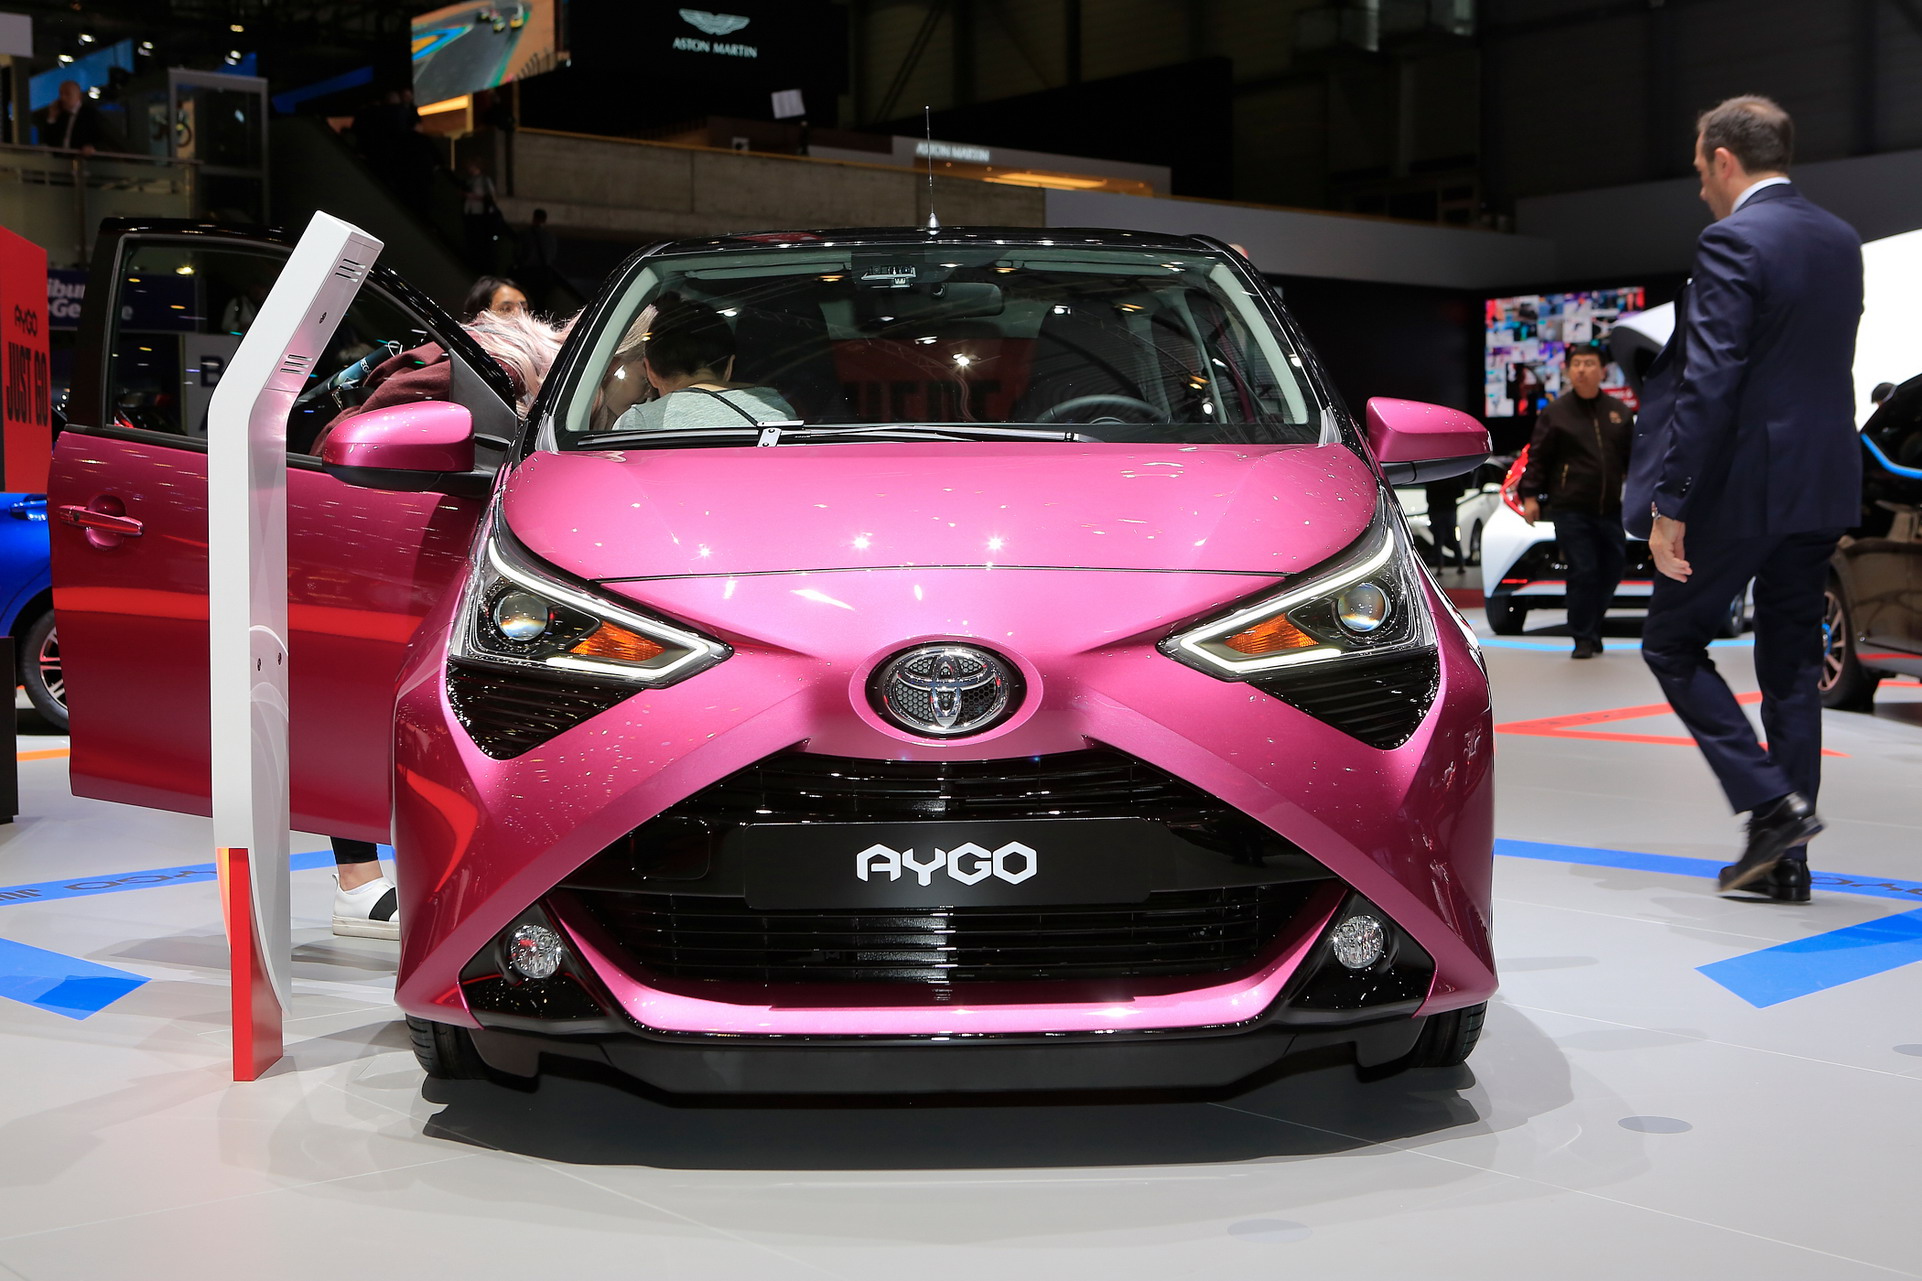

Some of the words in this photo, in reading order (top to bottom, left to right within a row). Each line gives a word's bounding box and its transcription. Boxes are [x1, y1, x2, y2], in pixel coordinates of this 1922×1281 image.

[672, 37, 710, 53] ASTON
[712, 42, 758, 58] MARTIN
[14, 304, 38, 337] AYGO
[6, 341, 32, 424] JUST
[34, 350, 48, 427] GO
[856, 841, 1038, 887] AYGO
